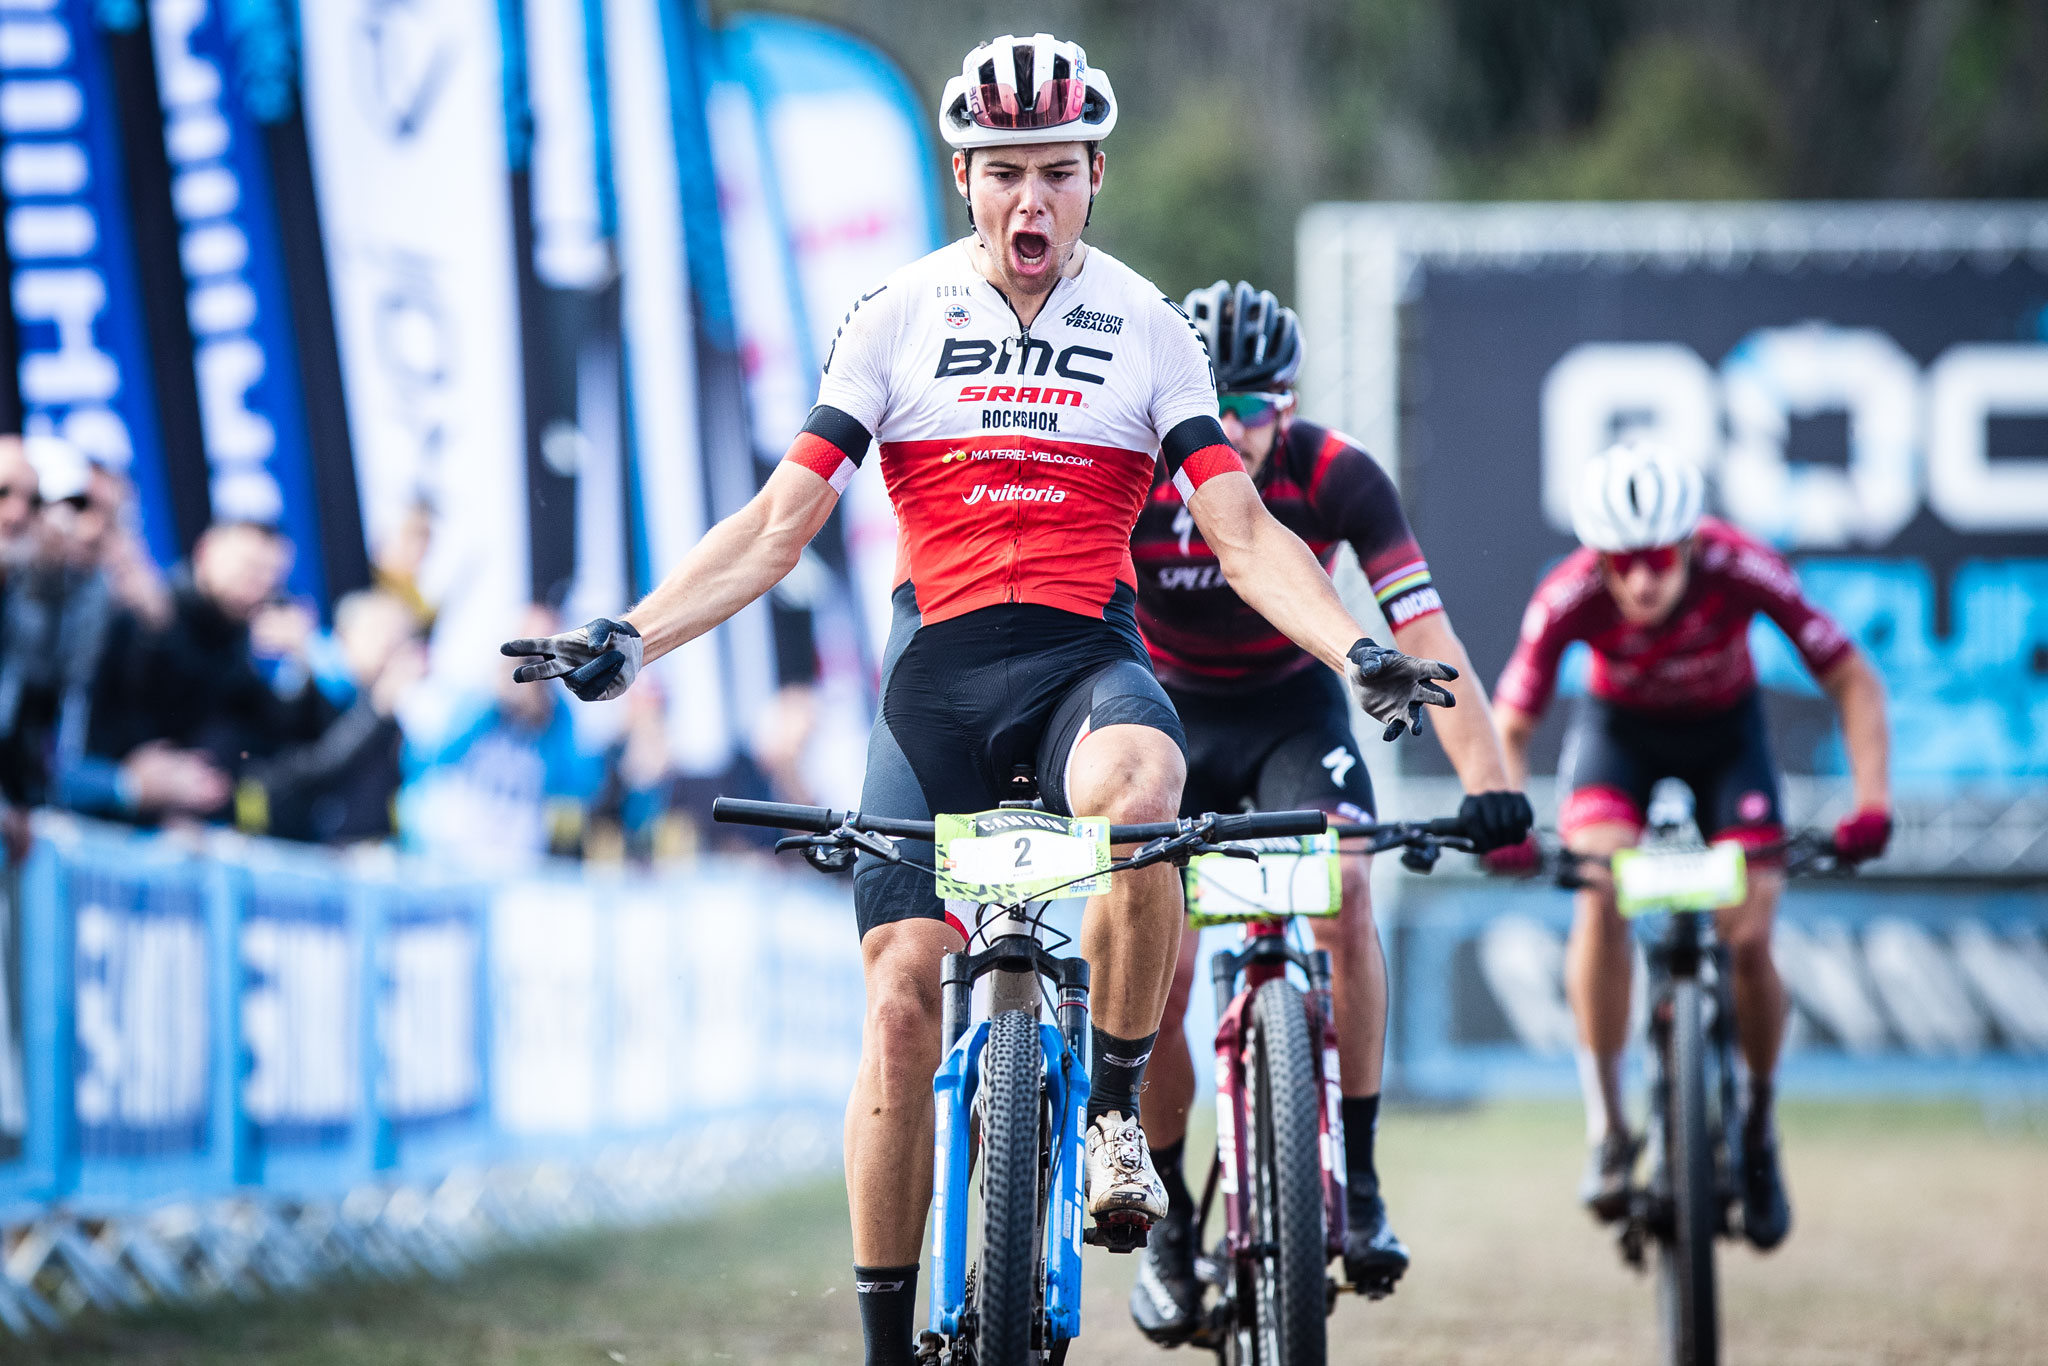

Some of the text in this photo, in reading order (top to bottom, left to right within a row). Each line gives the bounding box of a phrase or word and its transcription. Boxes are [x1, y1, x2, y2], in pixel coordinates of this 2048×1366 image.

[1061, 304, 1124, 327] ABSOLUTE
[1066, 318, 1122, 335] ABSALON
[934, 337, 1114, 385] BMC
[957, 385, 1083, 408] SRAM
[971, 449, 1094, 467] MATERIEL-VELO.COM
[987, 484, 1066, 503] vittoria
[978, 815, 1066, 832] CANYON
[1014, 837, 1032, 868] 2
[1260, 867, 1268, 894] 1
